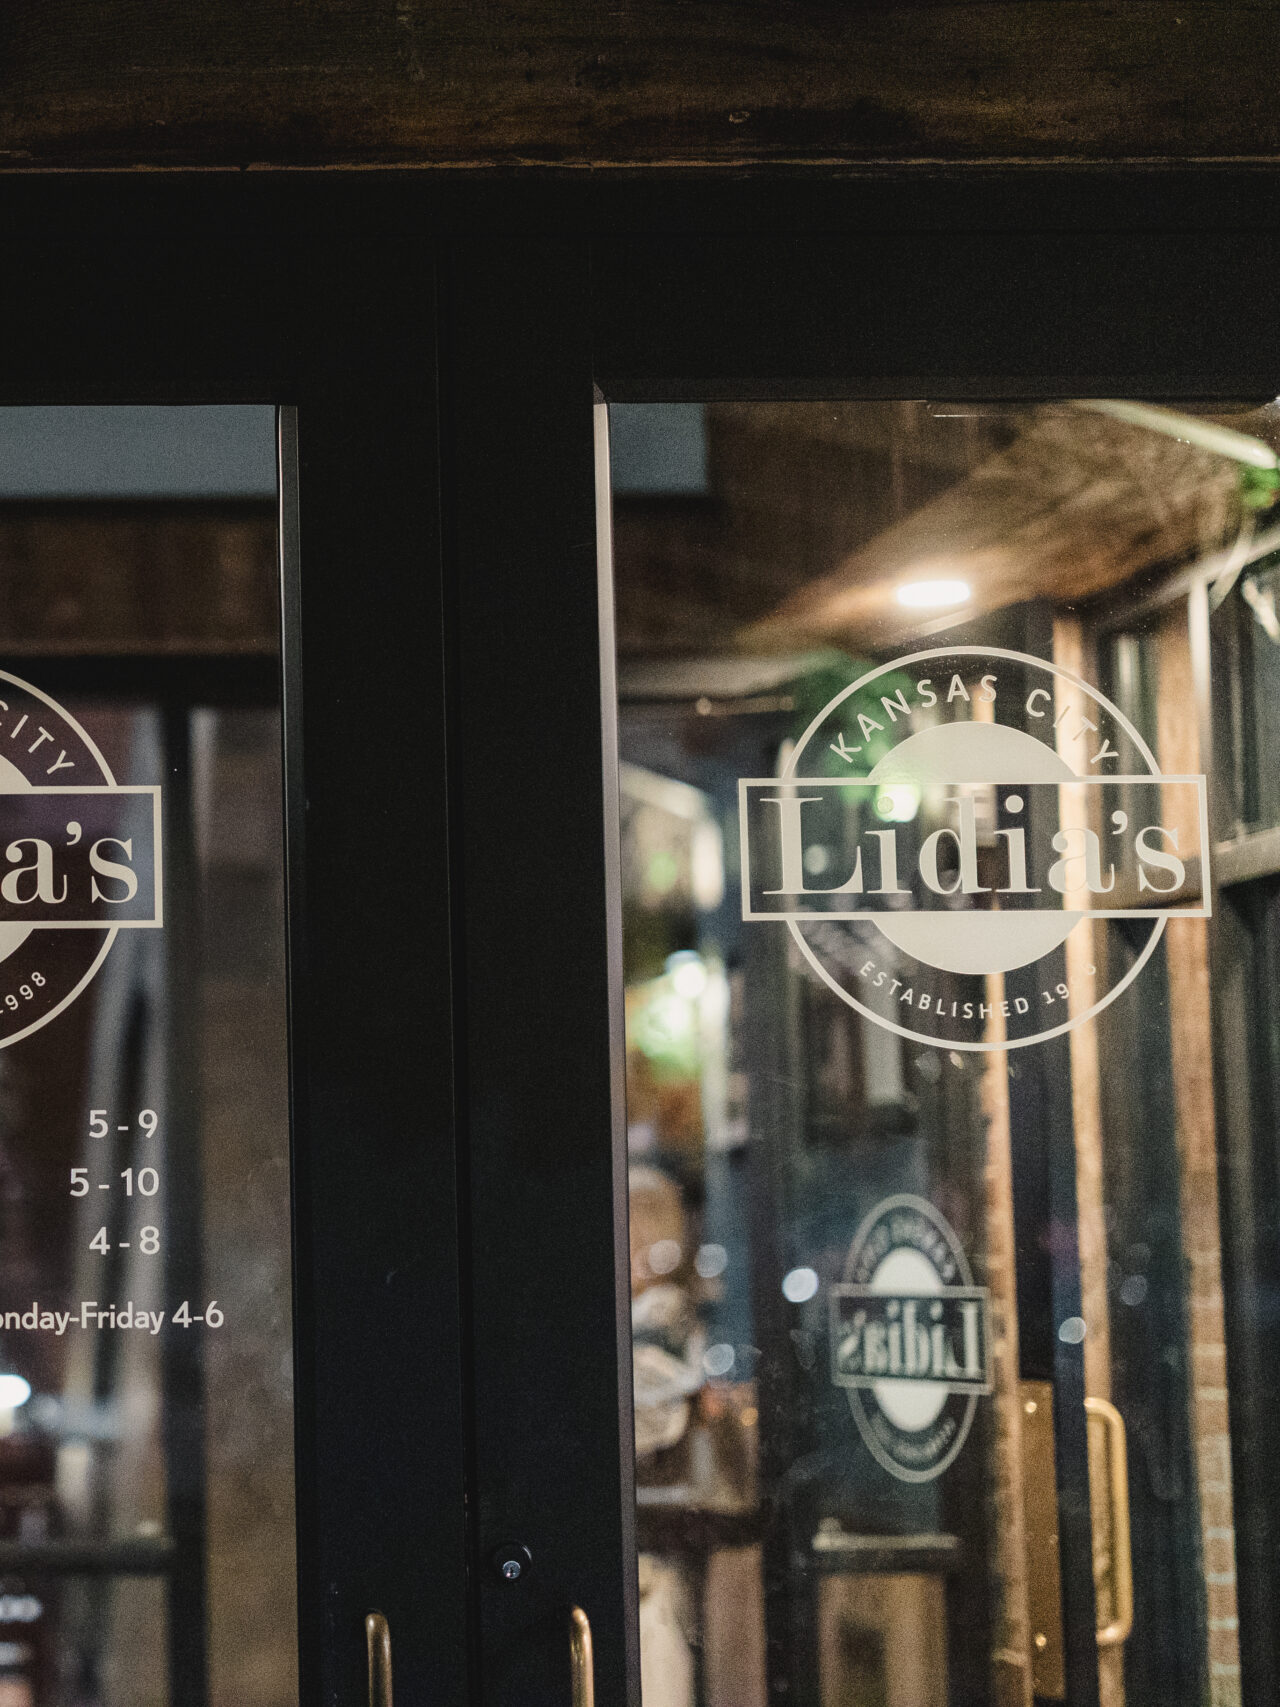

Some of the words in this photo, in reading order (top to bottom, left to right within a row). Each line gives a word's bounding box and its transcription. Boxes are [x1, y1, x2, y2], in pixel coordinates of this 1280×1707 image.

[830, 674, 998, 763] KANSAS
[1026, 688, 1119, 764] CITY
[759, 795, 1186, 895] Lidia's
[860, 960, 1029, 1020] ESTABLISHED
[1042, 961, 1097, 1005] 19
[88, 1110, 108, 1138] 5
[138, 1109, 159, 1138] 9
[69, 1168, 89, 1197] 5
[120, 1167, 160, 1196] 10
[89, 1227, 111, 1255] 4
[140, 1226, 160, 1255] 8
[172, 1301, 224, 1329] 4-6
